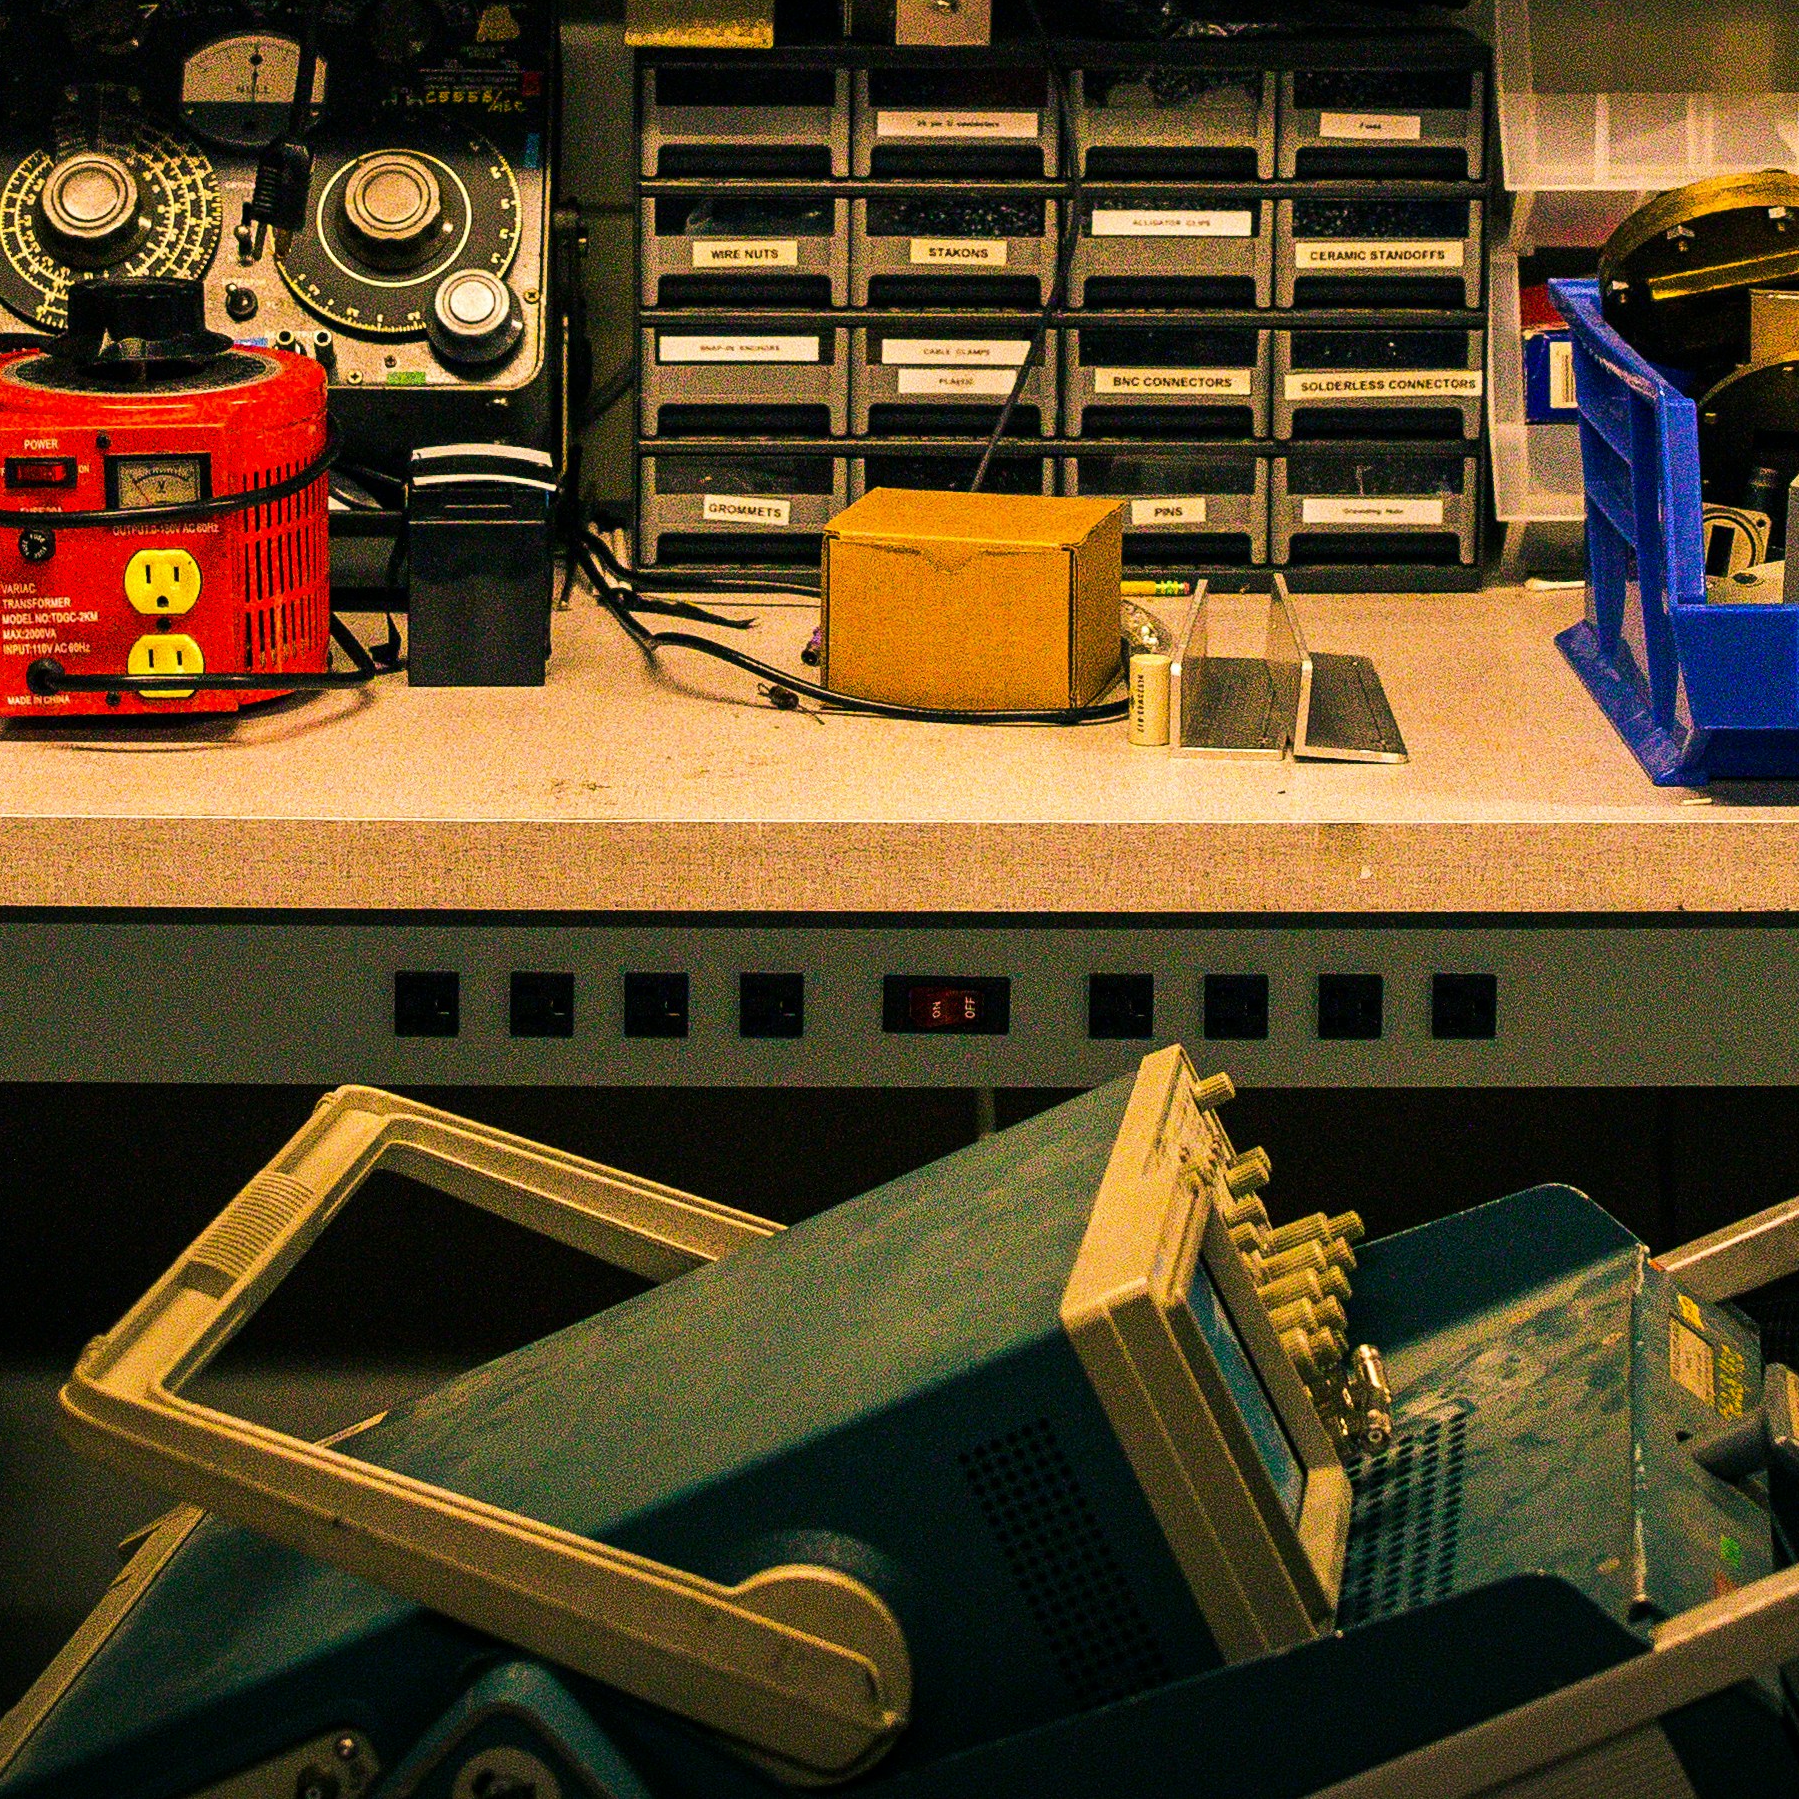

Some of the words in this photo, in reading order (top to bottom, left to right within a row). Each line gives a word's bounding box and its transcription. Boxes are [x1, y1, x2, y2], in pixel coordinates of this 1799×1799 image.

[1132, 219, 1182, 227] ALLIGATOR
[711, 248, 741, 260] WIRE
[744, 248, 779, 260] NUTS
[928, 247, 989, 259] STAKONS
[1310, 250, 1367, 261] CERAMIC
[1369, 249, 1446, 261] STANDOFFS
[1112, 376, 1139, 388] BNC
[1142, 376, 1232, 388] CONNECTORS
[1301, 380, 1385, 392] SOLDERLESS
[1388, 378, 1477, 390] CONNECTORS
[24, 439, 59, 450] POWER
[77, 464, 90, 474] ON
[708, 503, 783, 519] GROMMETS
[1153, 504, 1184, 519] PINS
[2, 582, 37, 595] VARIAC
[2, 596, 72, 609] TRANSFORMER
[2, 612, 34, 625] MODEL
[55, 643, 68, 654] AC
[7, 694, 32, 705] MADE
[32, 694, 42, 704] IN
[43, 694, 70, 705] CHINA
[932, 1000, 942, 1020] ON
[963, 995, 977, 1020] OFF
